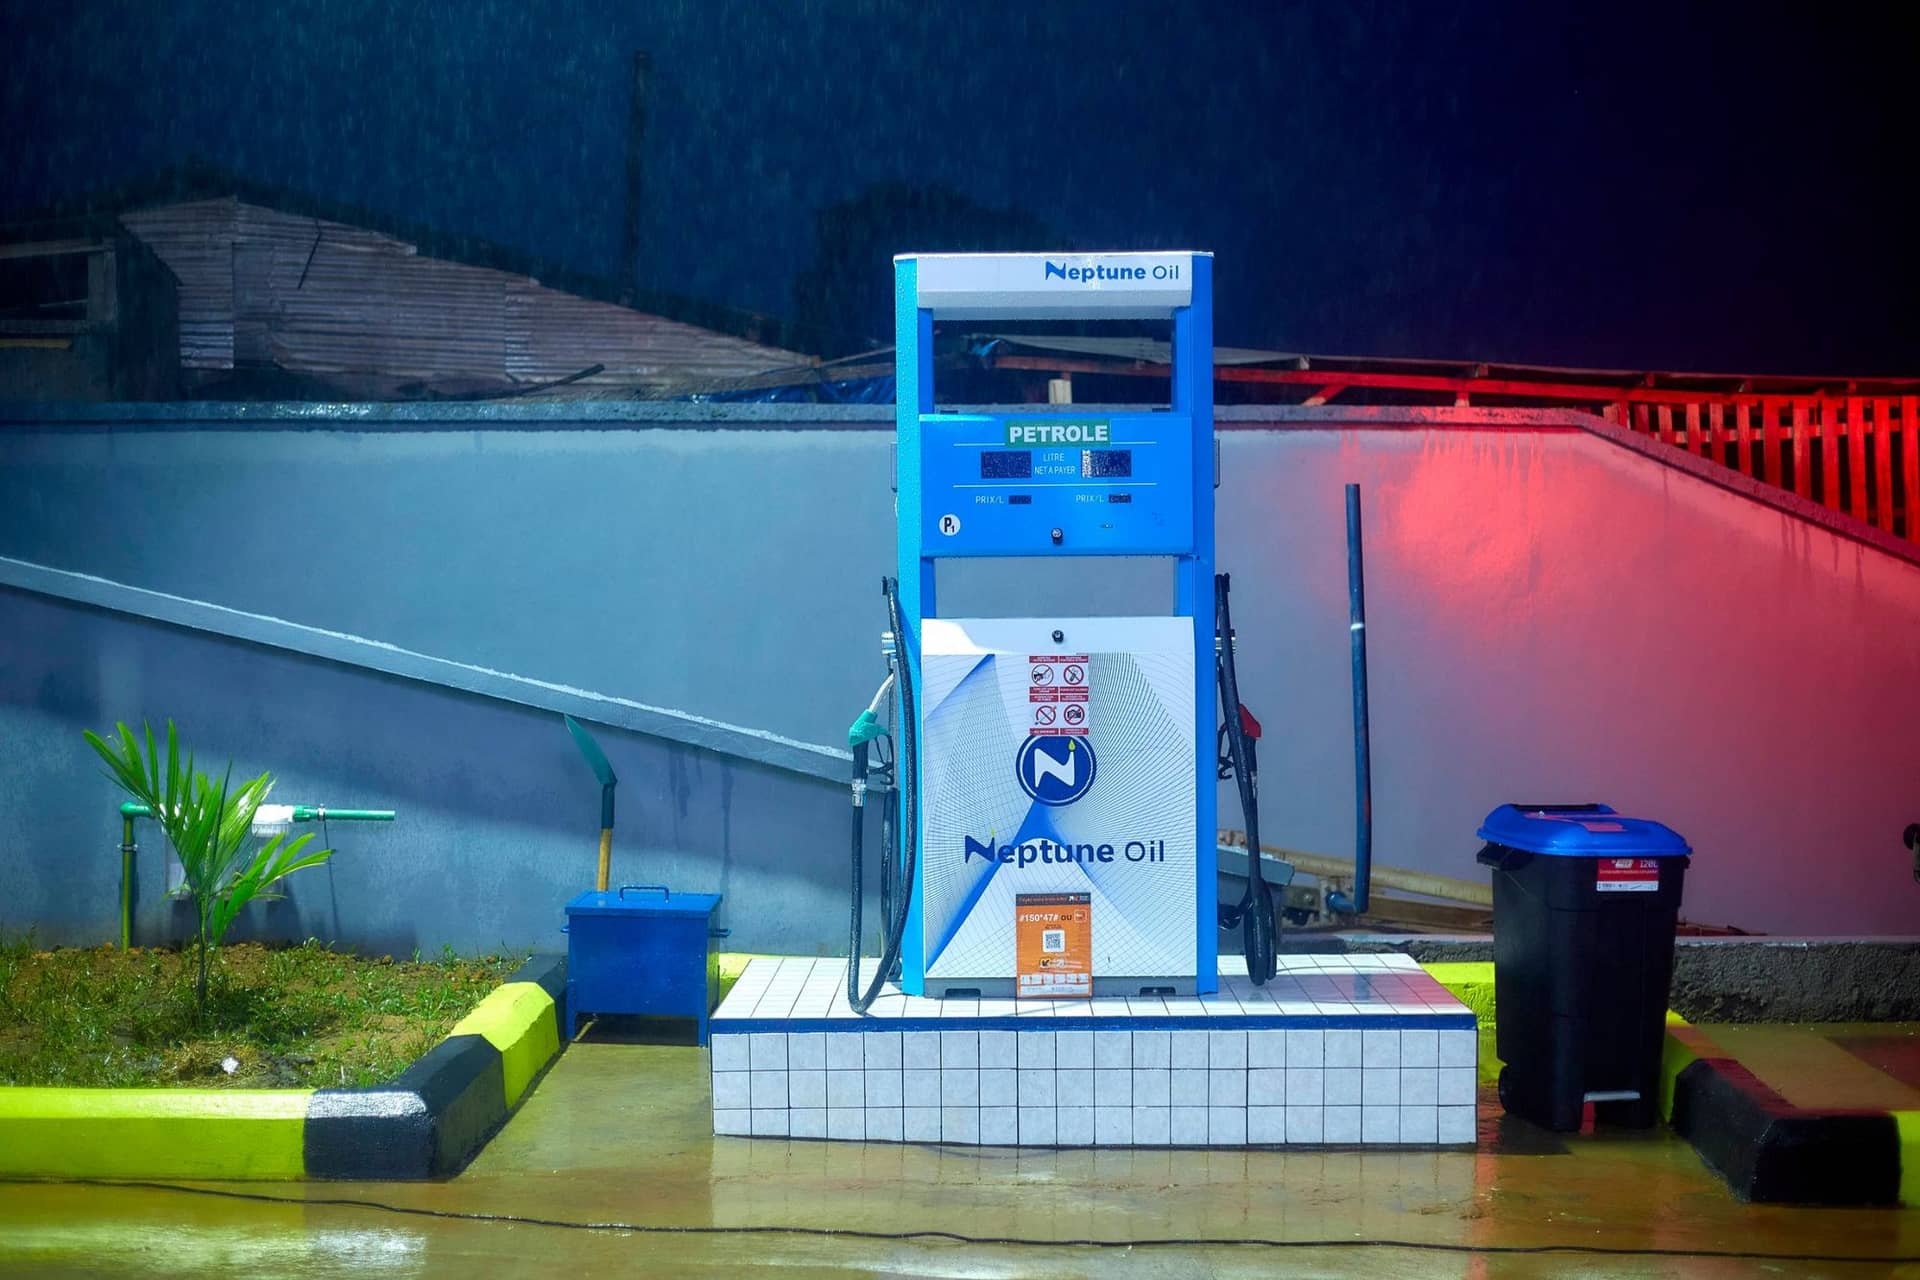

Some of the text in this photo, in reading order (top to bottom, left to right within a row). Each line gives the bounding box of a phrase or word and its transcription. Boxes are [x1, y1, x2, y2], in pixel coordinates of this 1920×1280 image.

[1045, 260, 1179, 283] Neptune Oil
[1009, 425, 1108, 443] PETROLE
[1043, 453, 1065, 462] LITRE
[1034, 466, 1047, 475] NET
[1054, 466, 1076, 475] PAYER
[975, 495, 1004, 505] PRIX/L
[964, 834, 1165, 869] Neptune Oil
